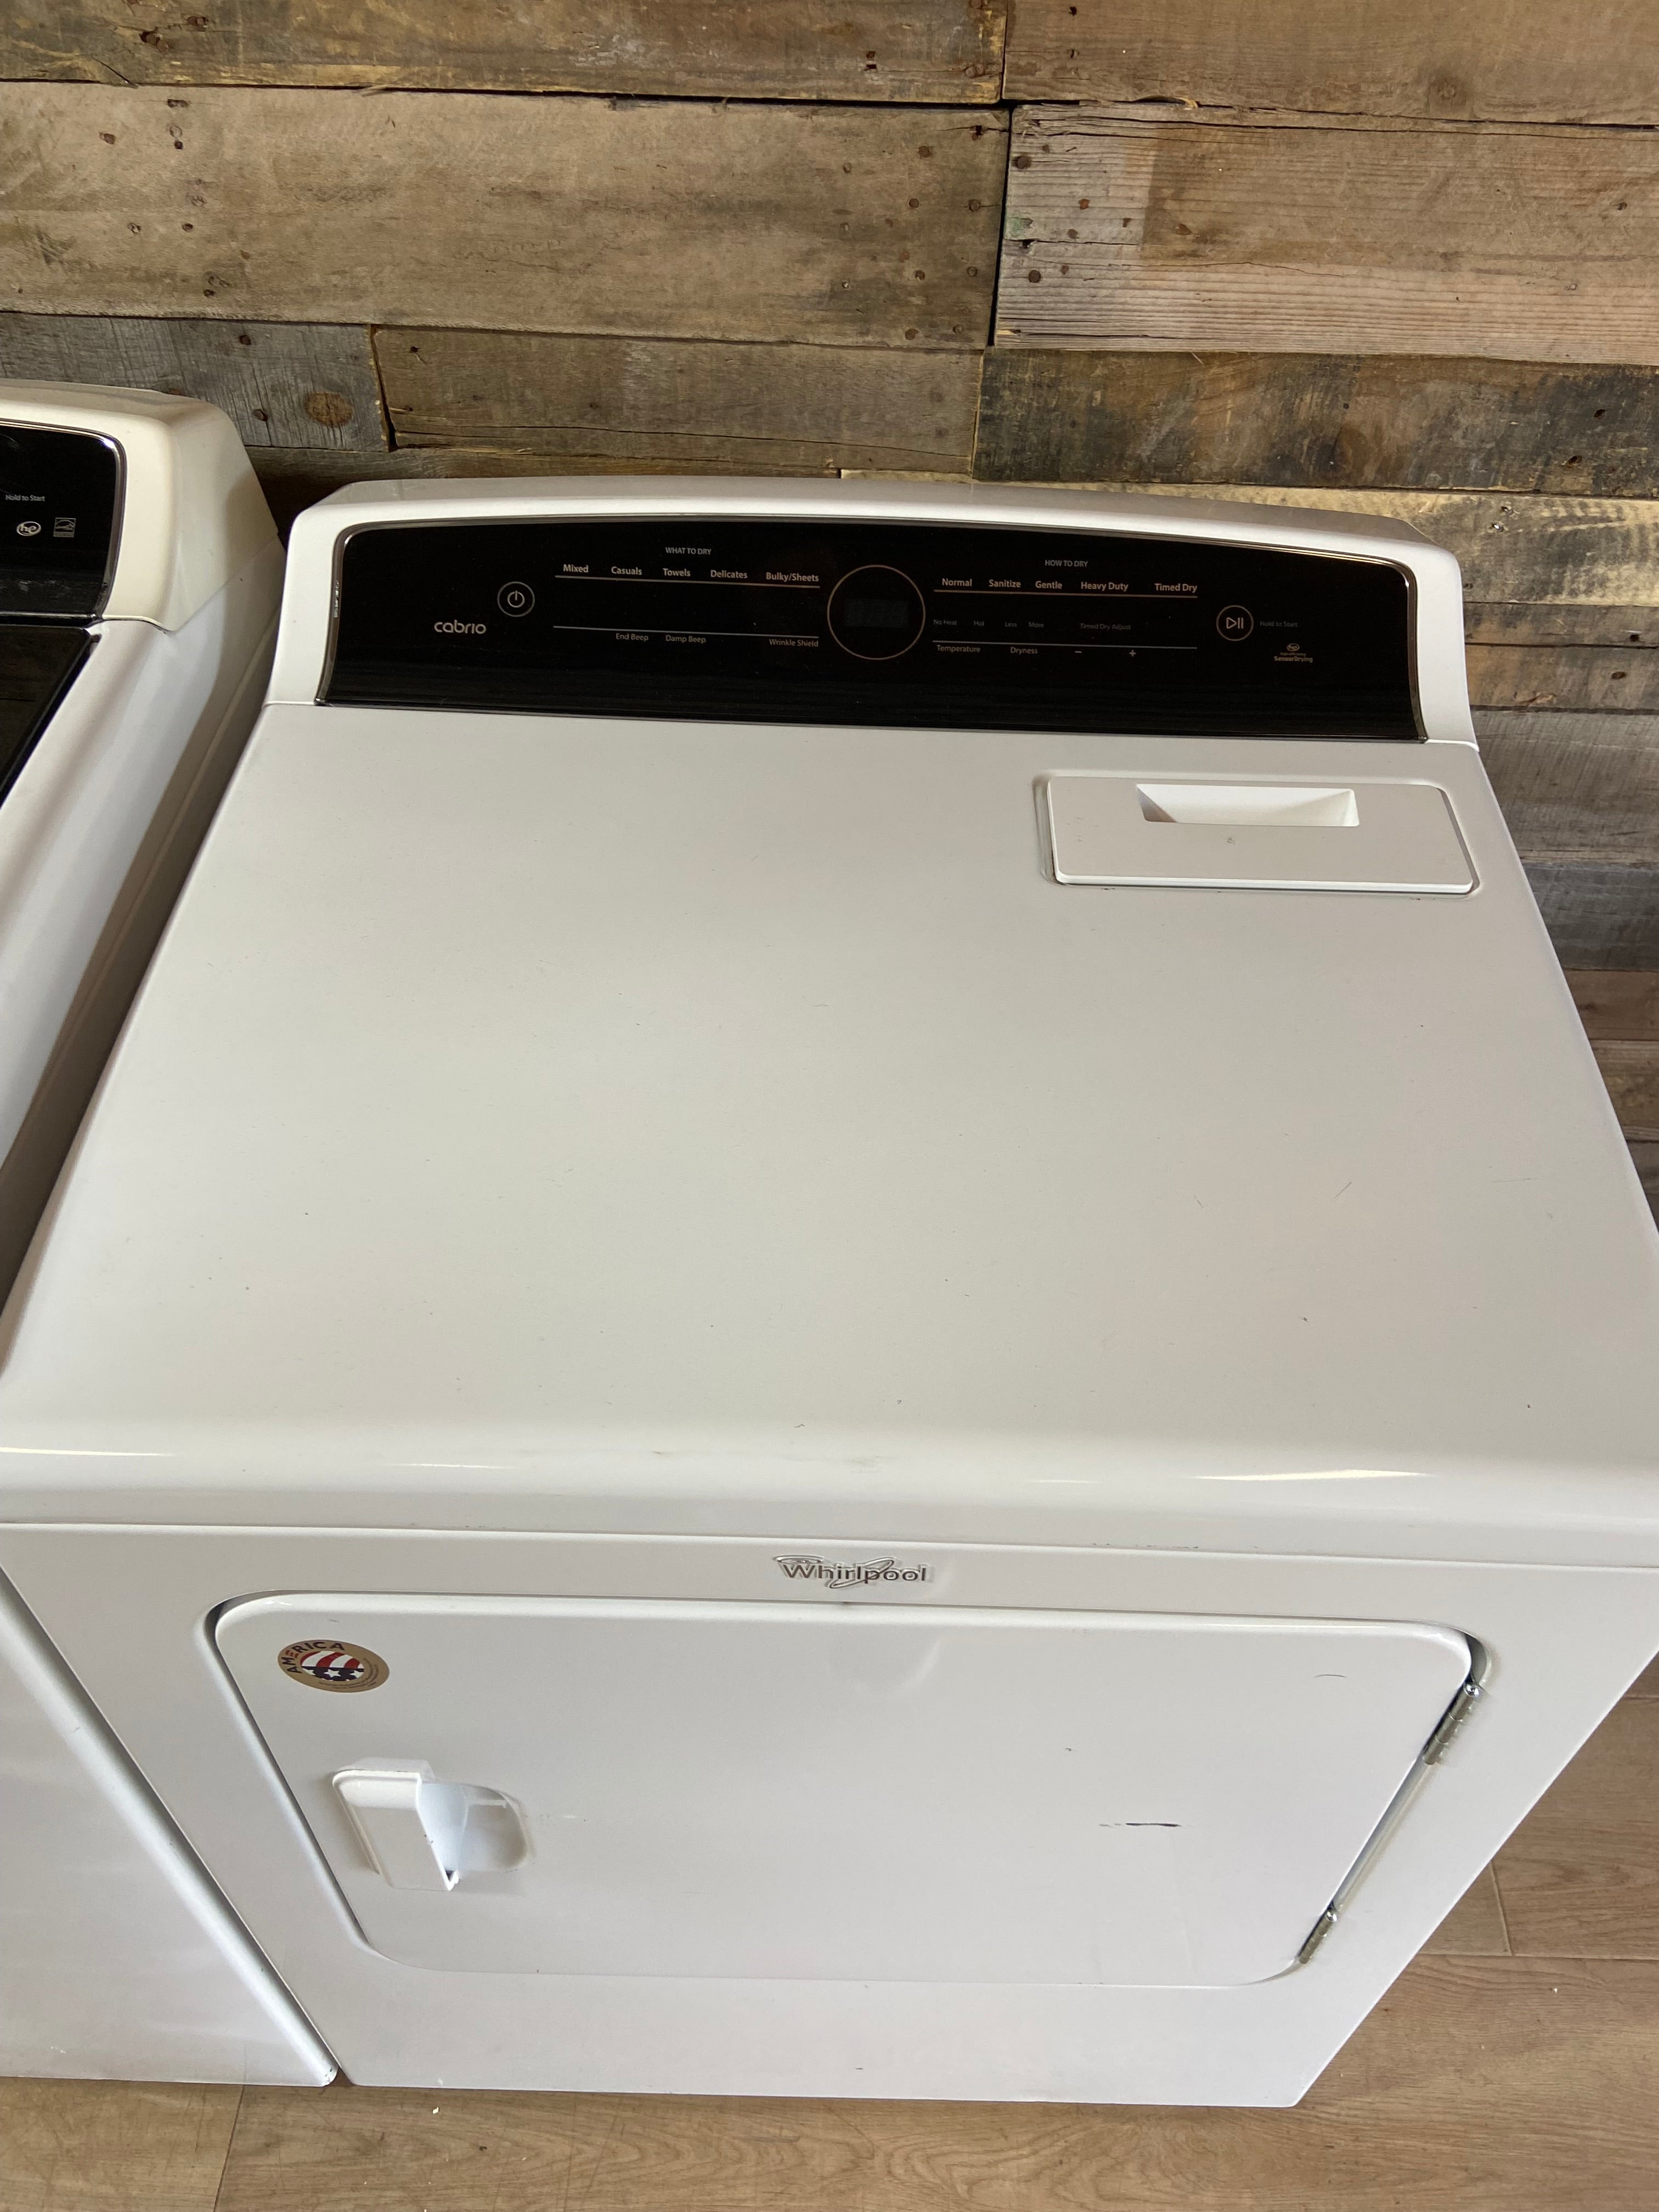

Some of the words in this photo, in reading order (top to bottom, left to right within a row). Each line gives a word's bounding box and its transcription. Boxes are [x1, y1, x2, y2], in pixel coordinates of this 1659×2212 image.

[562, 563, 589, 573] Mixed
[611, 566, 642, 575] Casuals
[662, 568, 691, 577] Towels
[710, 570, 748, 579] Delicates
[765, 572, 819, 582] Bulky/Sheets
[941, 578, 973, 587] Normal
[989, 579, 1022, 588] Sanitize
[1035, 580, 1063, 589] Gentle
[1080, 582, 1107, 591] Heavy
[1108, 582, 1129, 592] Duty
[1154, 583, 1181, 591] Timed
[1182, 584, 1198, 593] Dry
[434, 619, 487, 634] cabrio
[631, 633, 649, 642] Beep
[665, 635, 687, 643] Damp
[689, 635, 707, 644] Beep
[769, 638, 795, 646] Wrinkle
[797, 639, 819, 647] Shield
[936, 645, 981, 653] Temperature
[1010, 646, 1039, 655] Dryness
[780, 1562, 929, 1585] Whirlpool
[280, 1641, 346, 1674] AMERICA
